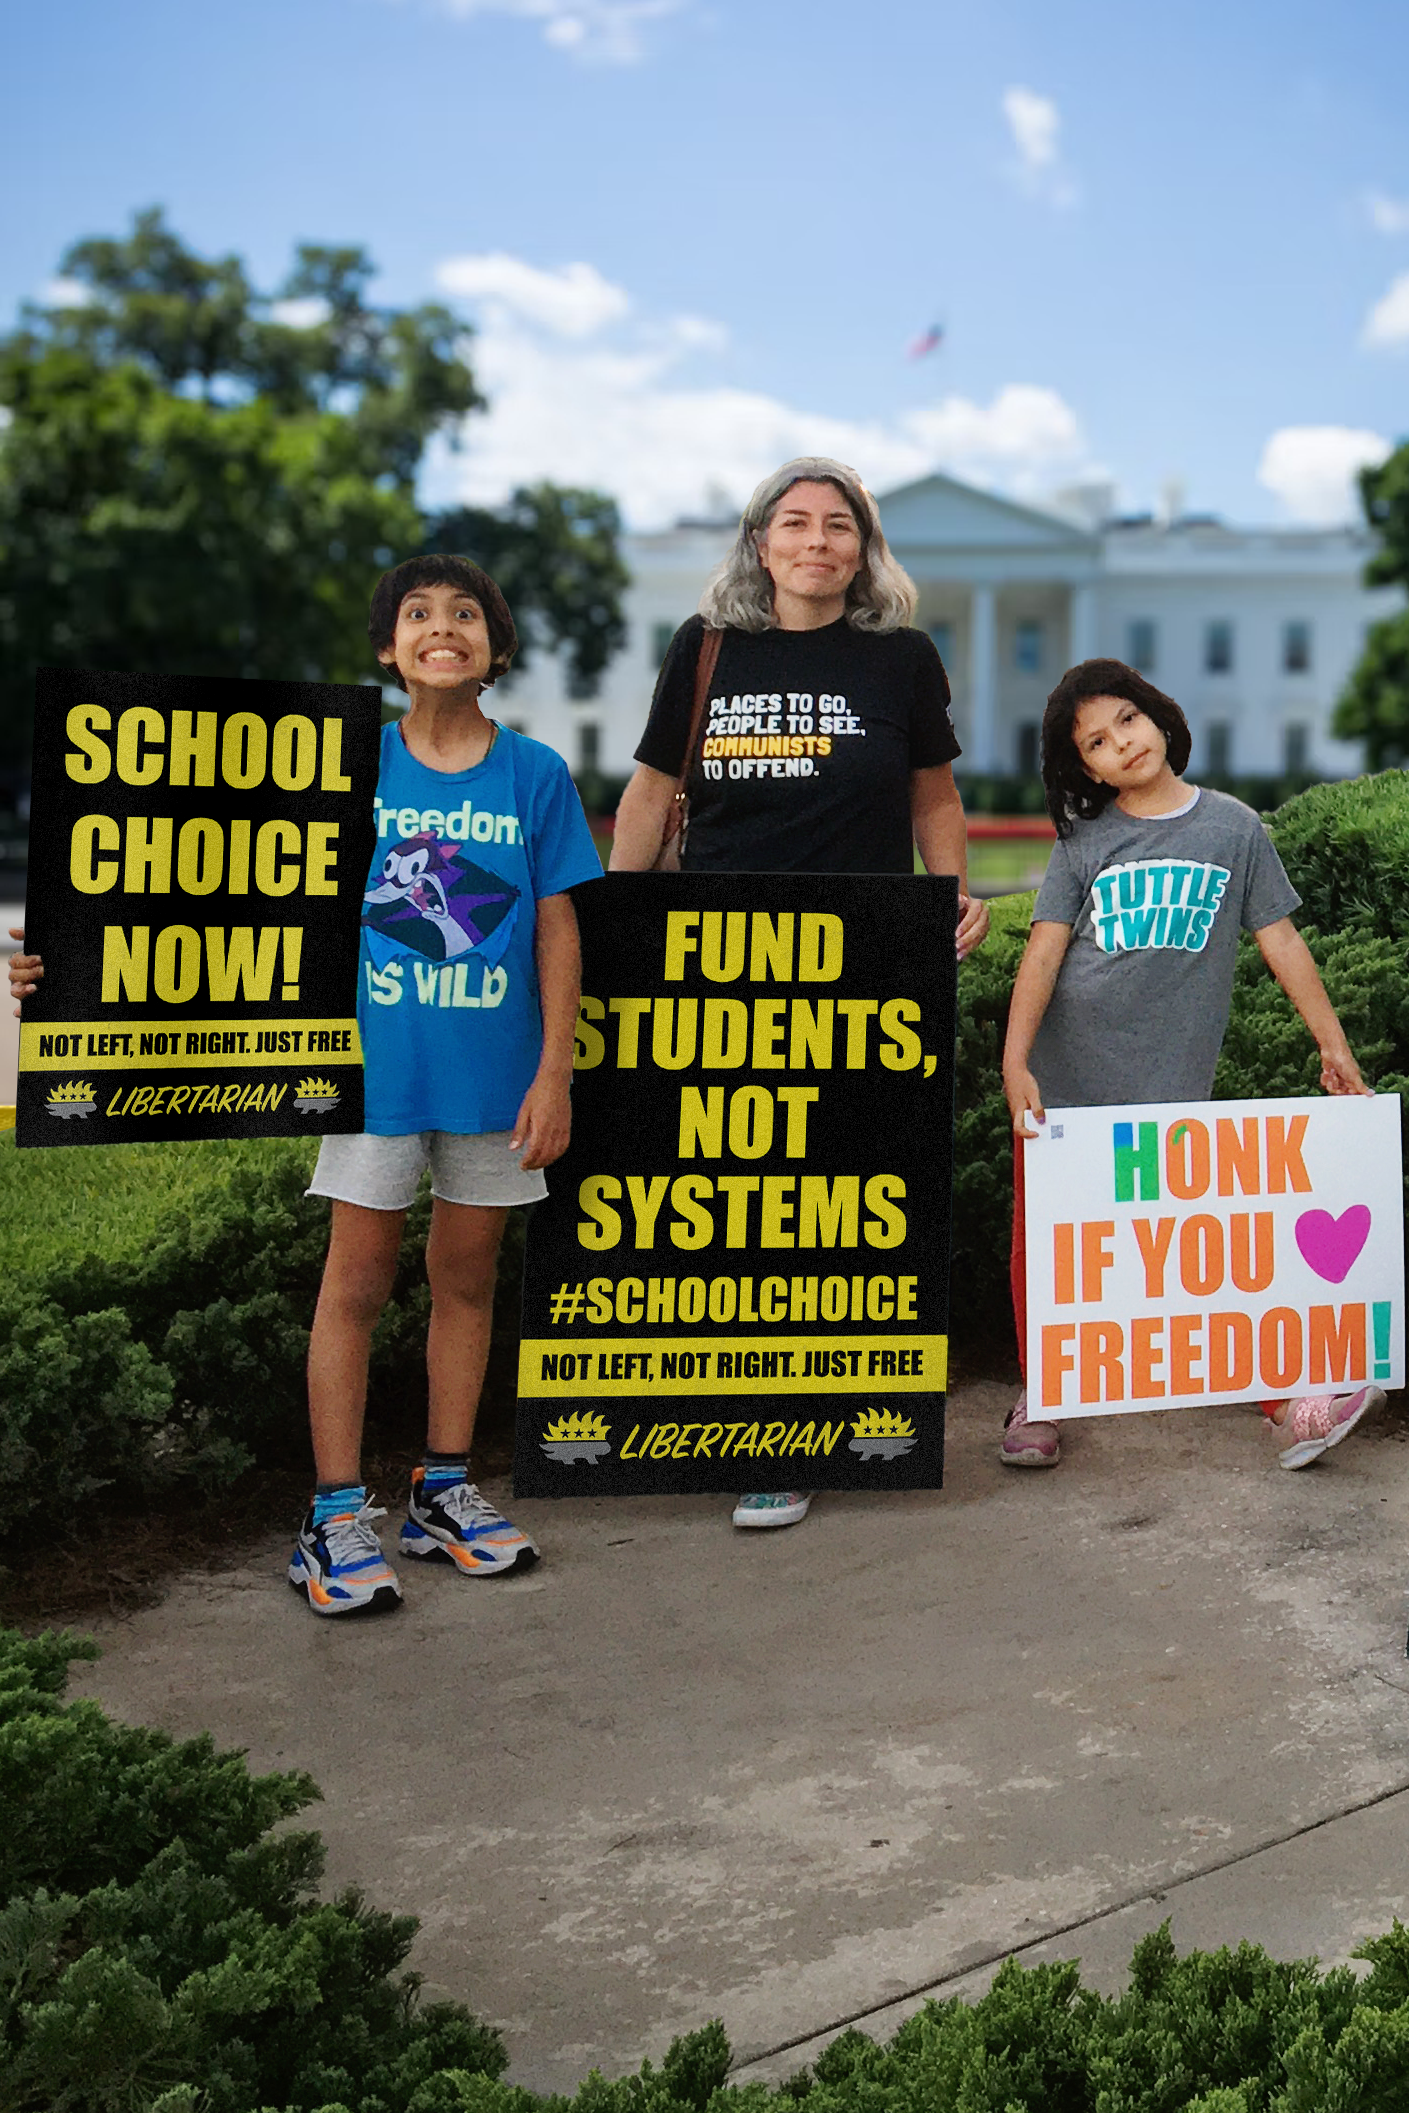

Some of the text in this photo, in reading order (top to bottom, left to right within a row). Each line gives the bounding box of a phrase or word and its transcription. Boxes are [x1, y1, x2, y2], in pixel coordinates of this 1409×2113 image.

[705, 715, 866, 737] PEOPLE TO SEE,
[709, 693, 851, 718] PLACES TO GO,
[65, 704, 351, 792] SCHOOL
[702, 758, 819, 780] TO OFFEND.
[703, 736, 831, 757] COMMUNISTS
[70, 814, 340, 897] CHOICE
[1094, 864, 1228, 912] TUTTLE
[664, 911, 844, 983] FUND
[1098, 907, 1214, 952] TWINS
[100, 924, 304, 1004] NOW!
[365, 960, 508, 1008] IS WILD
[39, 1029, 351, 1059] NOT LEFT, NOT RIGHT. JUST FREE
[573, 997, 937, 1079] STUDENTS,
[106, 1082, 288, 1116] LIBERTARIAN
[678, 1085, 819, 1160] NOT
[1113, 1114, 1312, 1202] HONK
[576, 1174, 907, 1250] SYSTEMS
[1053, 1211, 1274, 1304] IF YOU
[549, 1276, 918, 1324] #SCHOOLCHOICE
[541, 1349, 924, 1382] NOT LEFT, NOT RIGHT. JUST FREE
[1041, 1301, 1392, 1407] FREEDOM!
[619, 1420, 844, 1460] LIBERTARIAN
